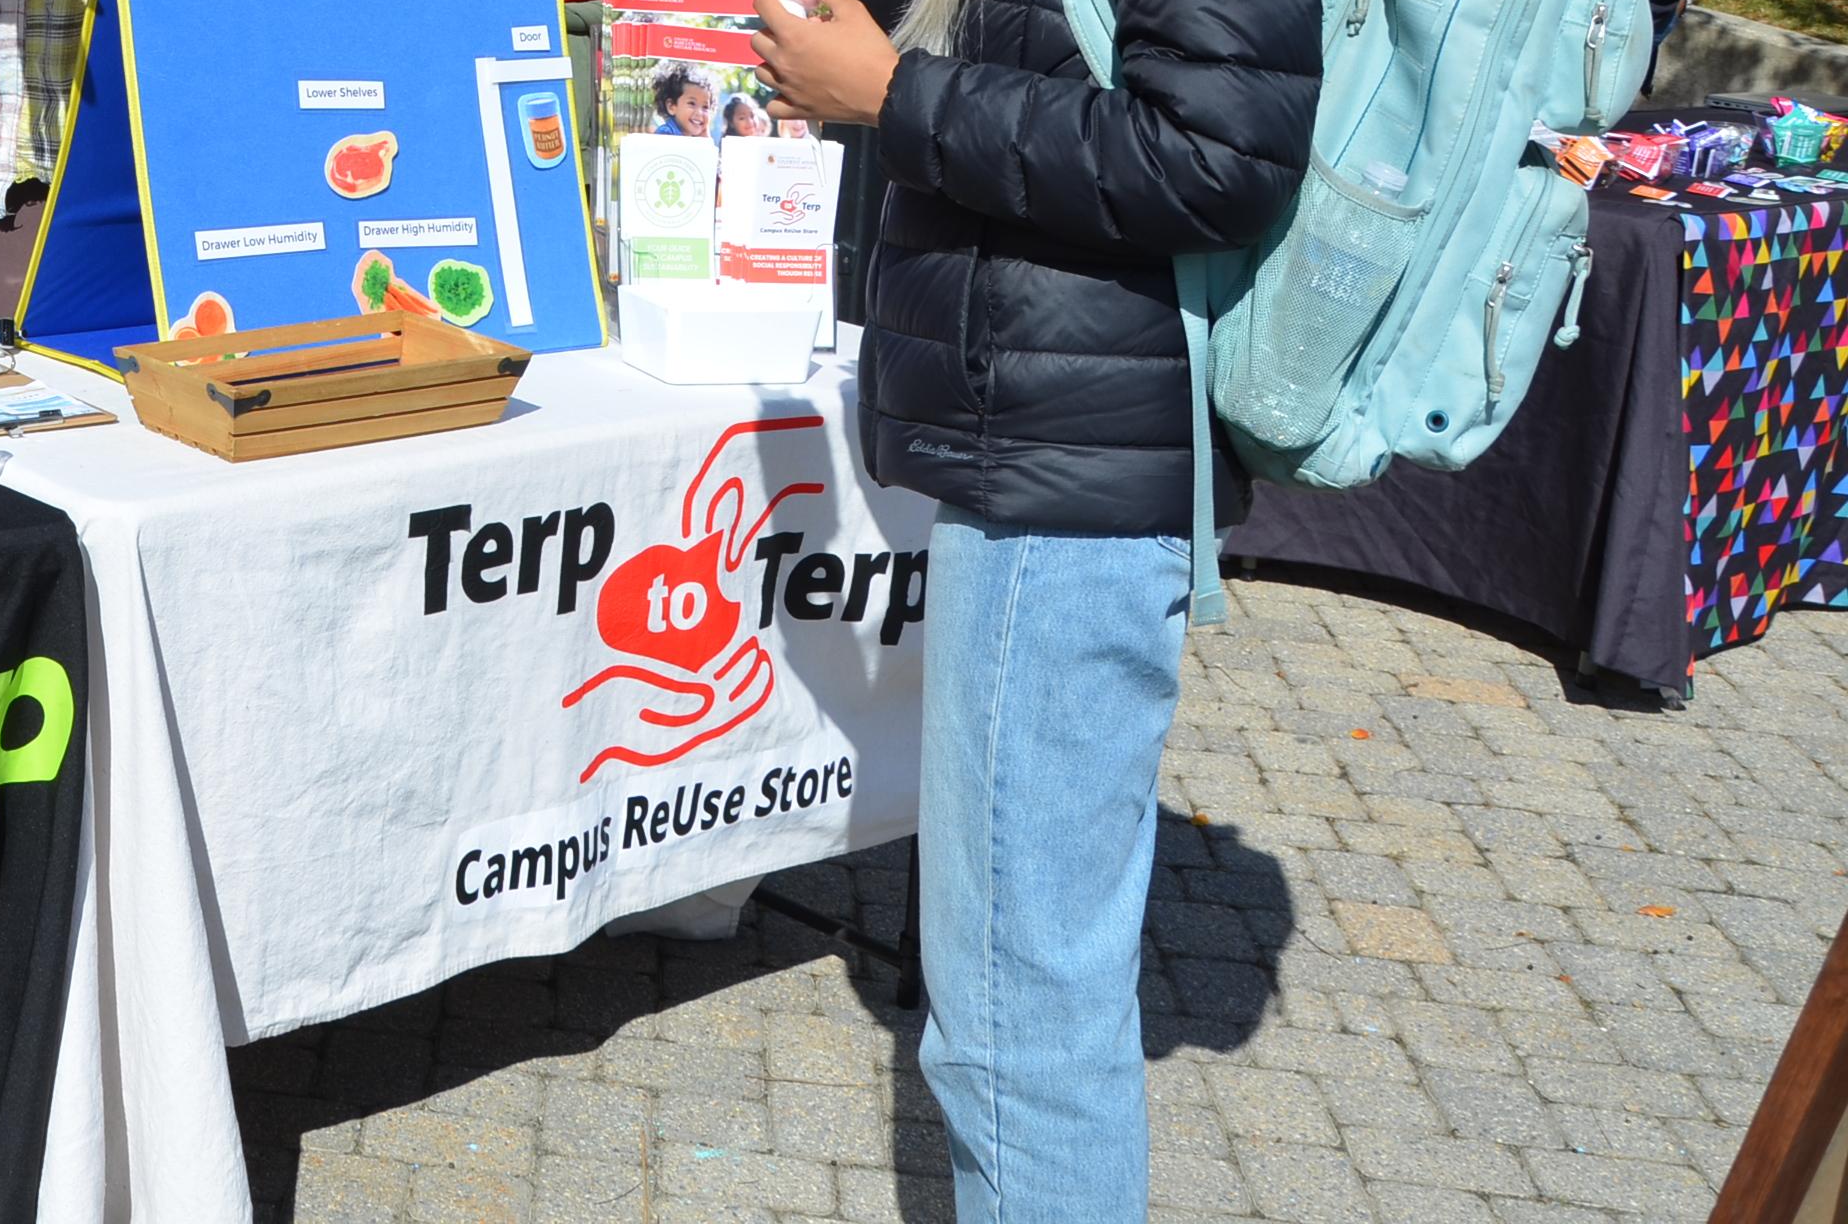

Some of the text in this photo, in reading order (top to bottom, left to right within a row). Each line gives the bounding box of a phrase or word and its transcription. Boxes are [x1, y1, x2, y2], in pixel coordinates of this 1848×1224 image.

[519, 32, 542, 42] Door
[306, 86, 378, 98] Lower Shelves
[762, 194, 781, 204] Terp
[802, 202, 821, 212] Terp
[363, 221, 473, 236] Drawer High Humidity
[202, 230, 318, 251] Drawer Low Humidity
[408, 501, 929, 647] Terp to Terp
[455, 752, 853, 906] Campus ReUse Store
